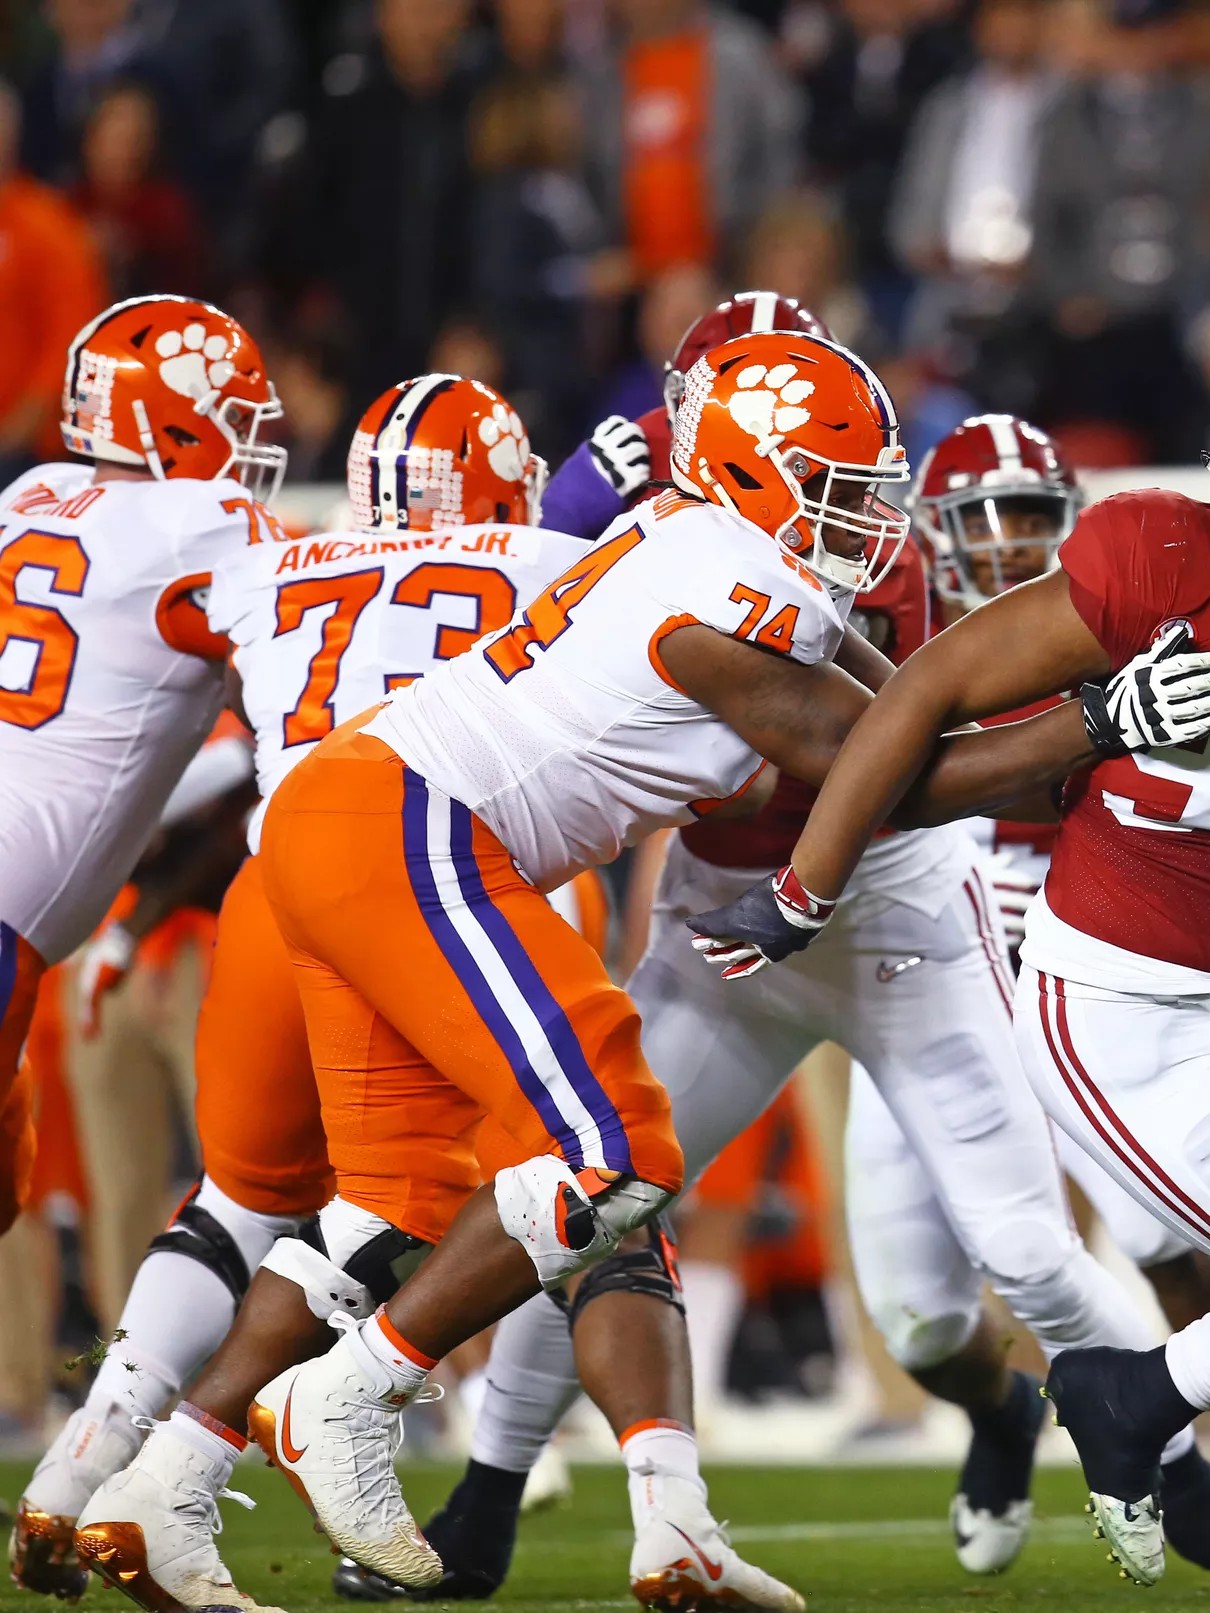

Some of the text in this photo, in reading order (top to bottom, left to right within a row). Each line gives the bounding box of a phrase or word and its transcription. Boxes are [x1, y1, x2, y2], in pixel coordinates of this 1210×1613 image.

[461, 532, 518, 558] JR.
[728, 582, 801, 654] 74
[275, 562, 517, 750] 73
